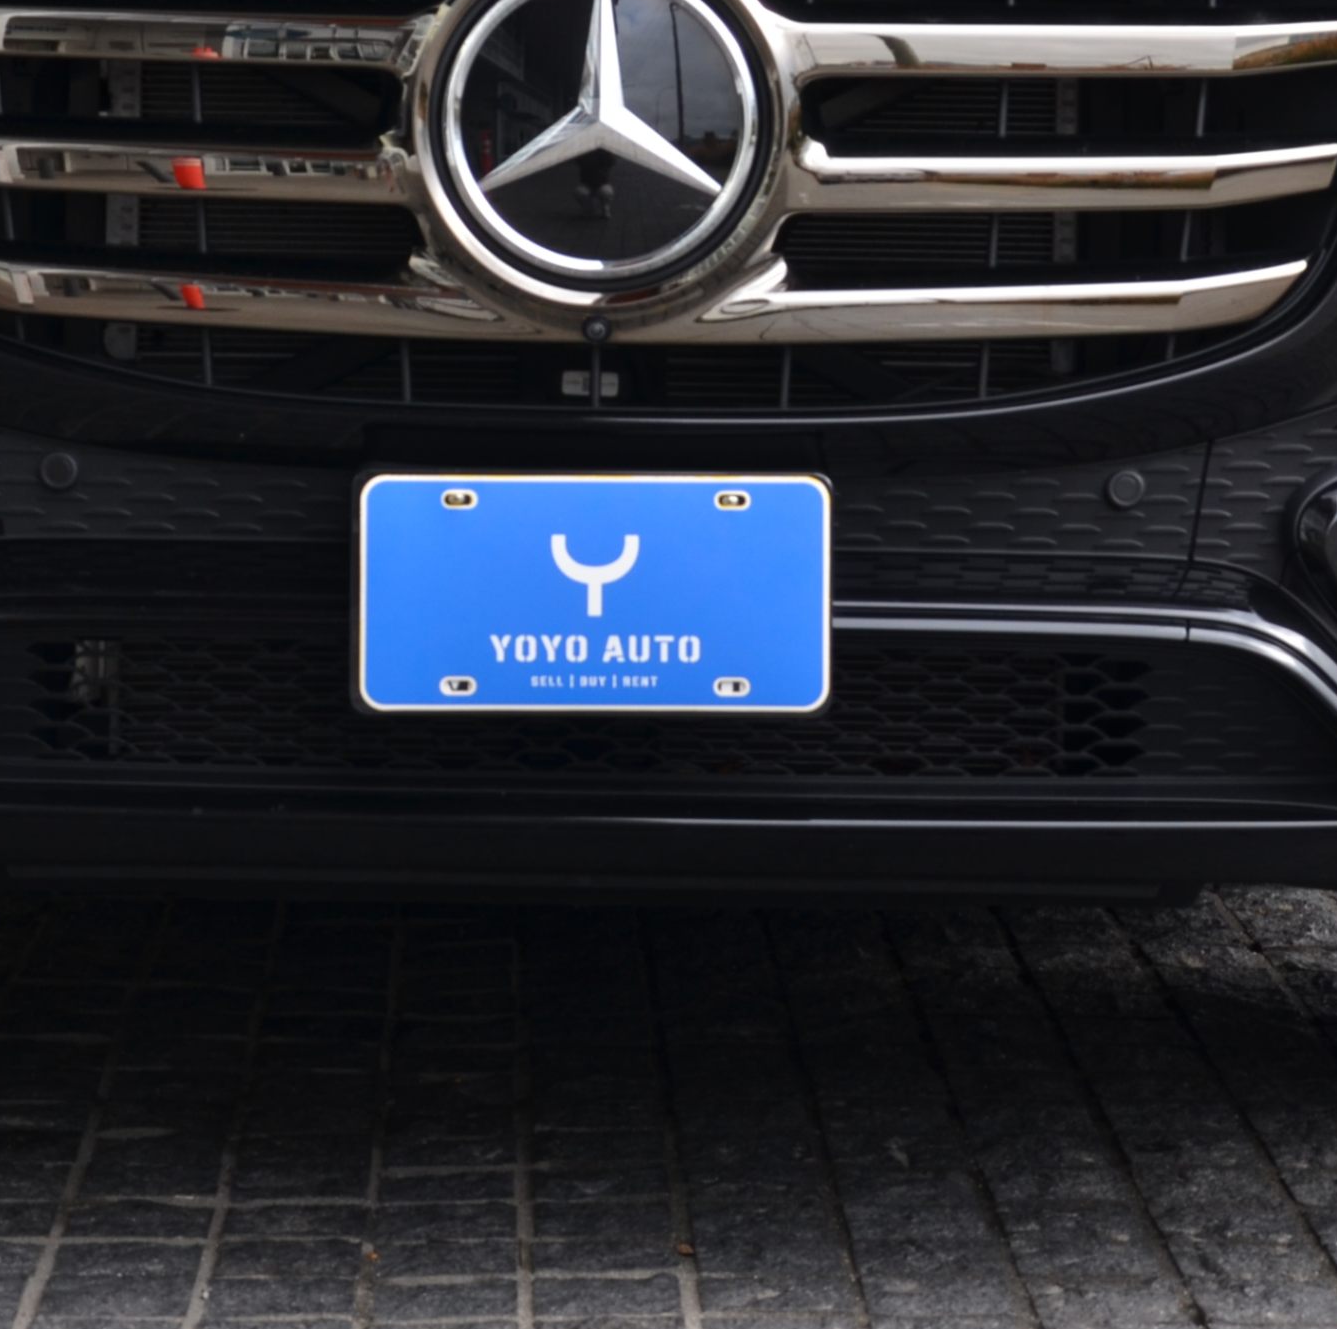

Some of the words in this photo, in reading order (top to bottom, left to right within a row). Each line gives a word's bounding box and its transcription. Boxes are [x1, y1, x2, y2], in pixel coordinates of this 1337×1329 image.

[489, 634, 588, 664] YOYO
[602, 634, 701, 665] AUTO
[530, 675, 564, 688] SELL
[622, 675, 659, 688] RENT
